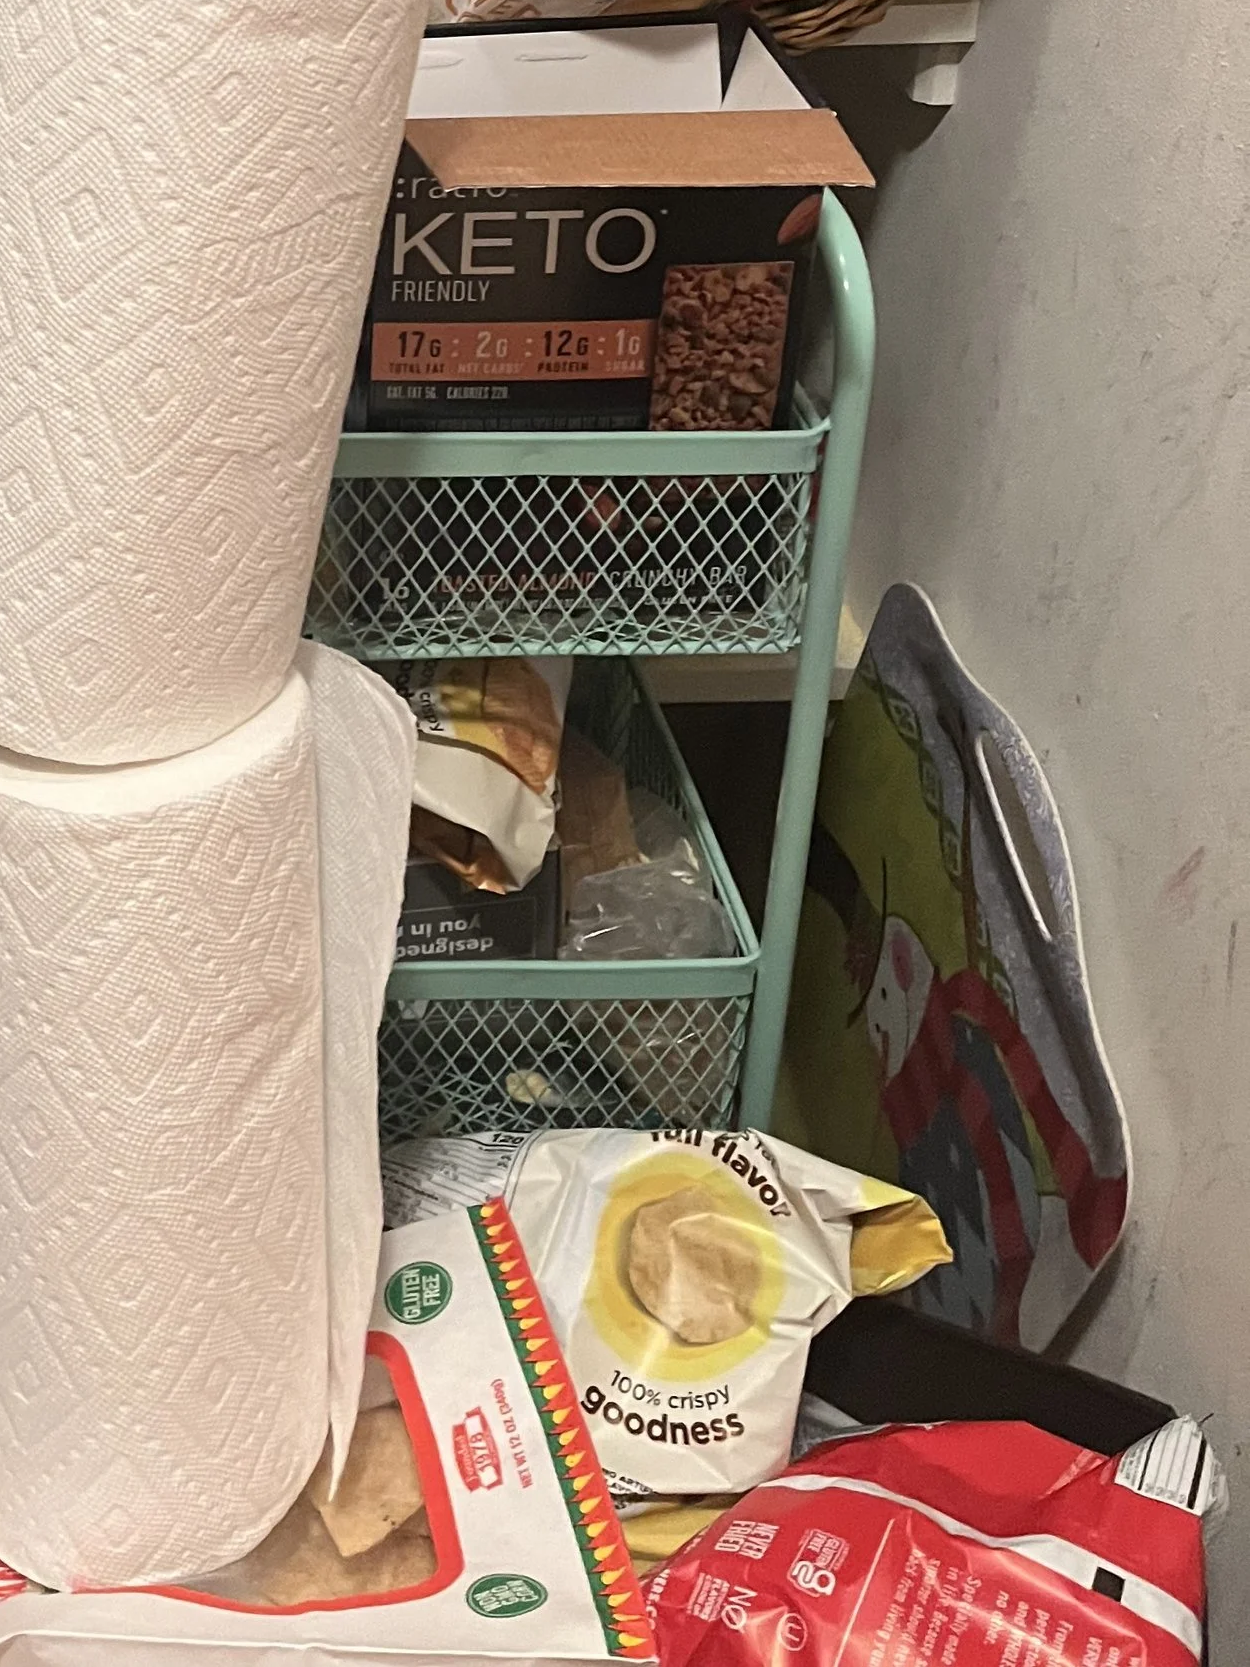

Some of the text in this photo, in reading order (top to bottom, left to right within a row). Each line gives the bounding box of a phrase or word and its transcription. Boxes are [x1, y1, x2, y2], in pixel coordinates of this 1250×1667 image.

[391, 206, 658, 276] KETO
[390, 279, 491, 303] FRIENDLY
[397, 330, 442, 359] 17G
[475, 330, 508, 359] 2G
[543, 329, 589, 357] 12G
[388, 362, 421, 374] TOTAL
[424, 362, 445, 373] FAT
[536, 361, 589, 373] PROTEIN
[605, 360, 645, 373] SUGAR
[518, 570, 596, 591] ALMOND
[609, 566, 702, 588] CRUNCHY
[708, 564, 748, 585] BAR
[418, 690, 444, 732] crispy
[491, 1132, 525, 1145] 120
[402, 1267, 421, 1321] GLUTEN
[422, 1273, 440, 1306] FREE
[610, 1369, 730, 1410] 100% crispy
[580, 1385, 745, 1446] goodness
[469, 1431, 494, 1474] 1978
[714, 1520, 755, 1552] FRIED
[739, 1522, 780, 1560] NEVER
